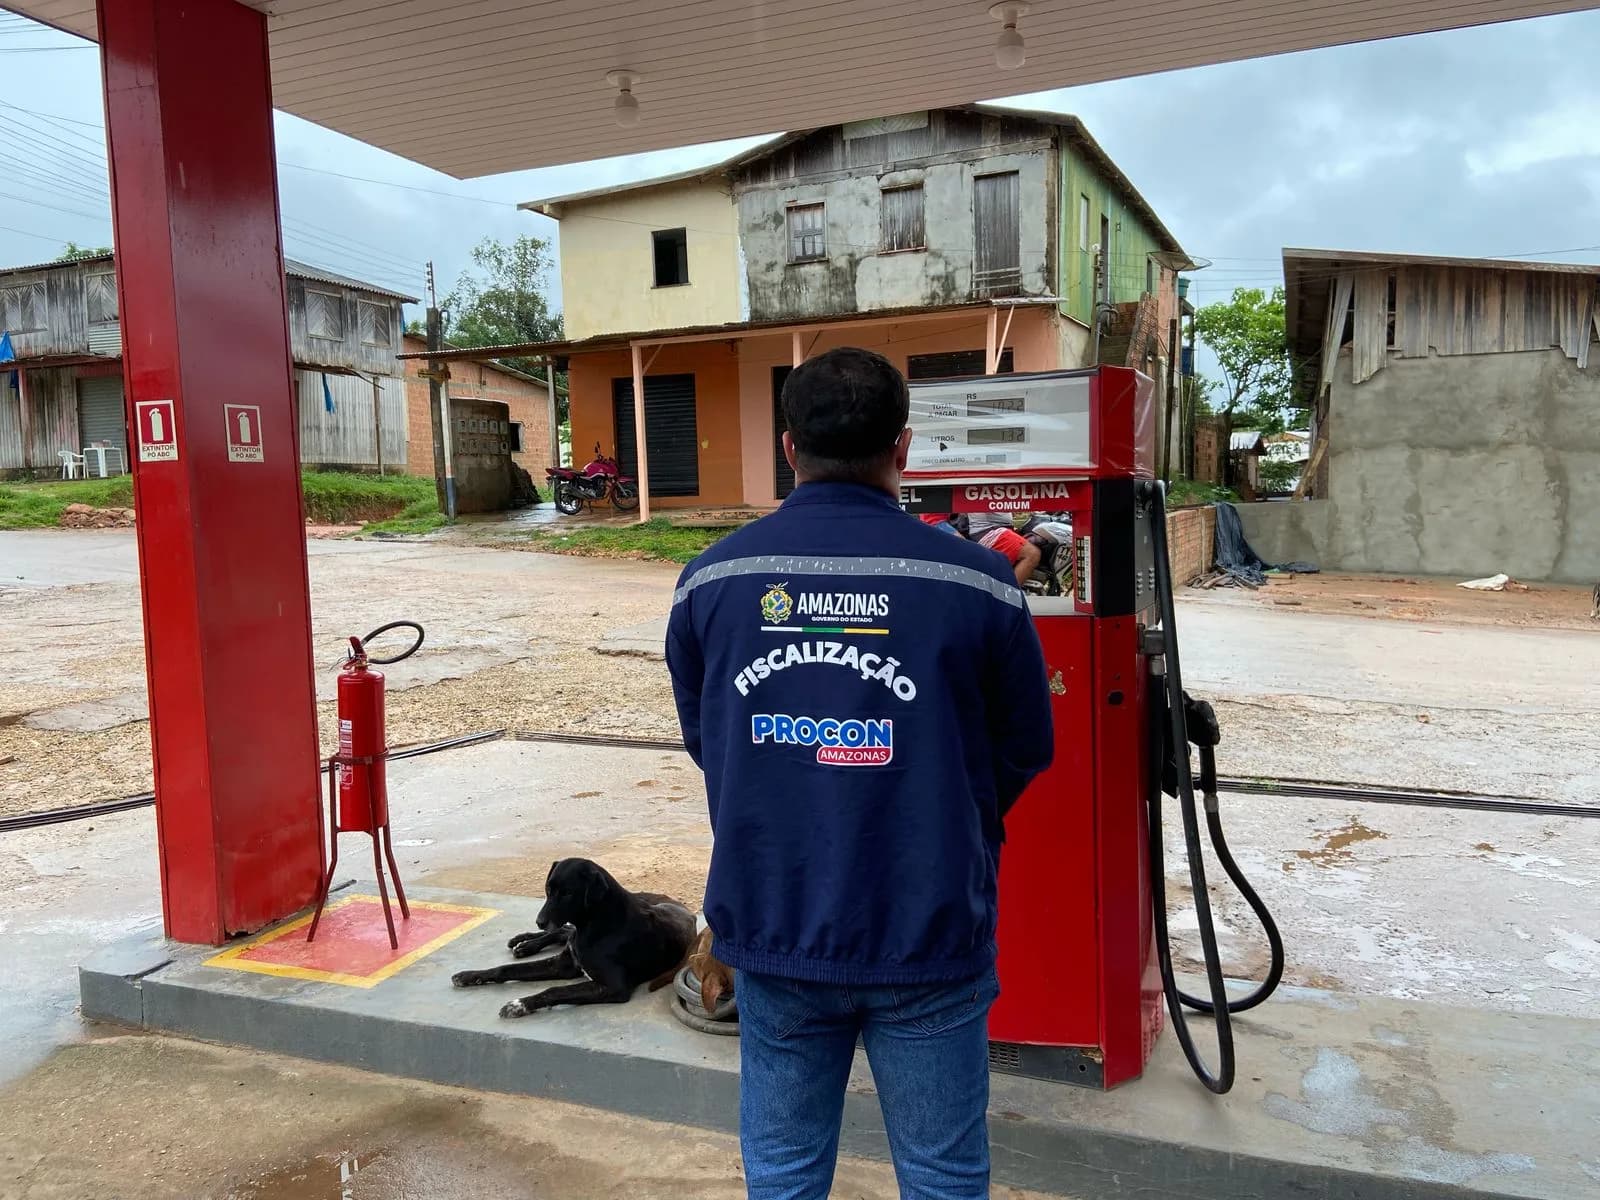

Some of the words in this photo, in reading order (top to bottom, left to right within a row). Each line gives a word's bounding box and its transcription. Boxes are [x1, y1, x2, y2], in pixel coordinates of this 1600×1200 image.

[931, 435, 955, 443] LITROS
[899, 488, 922, 503] EL
[964, 483, 1069, 501] GASOLINA
[988, 501, 1030, 510] COMUM
[796, 592, 889, 616] AMAZONAS
[733, 641, 917, 701] FISCALIZAÇÃO
[752, 714, 892, 747] PROCON
[820, 750, 887, 761] AMAZONAS
